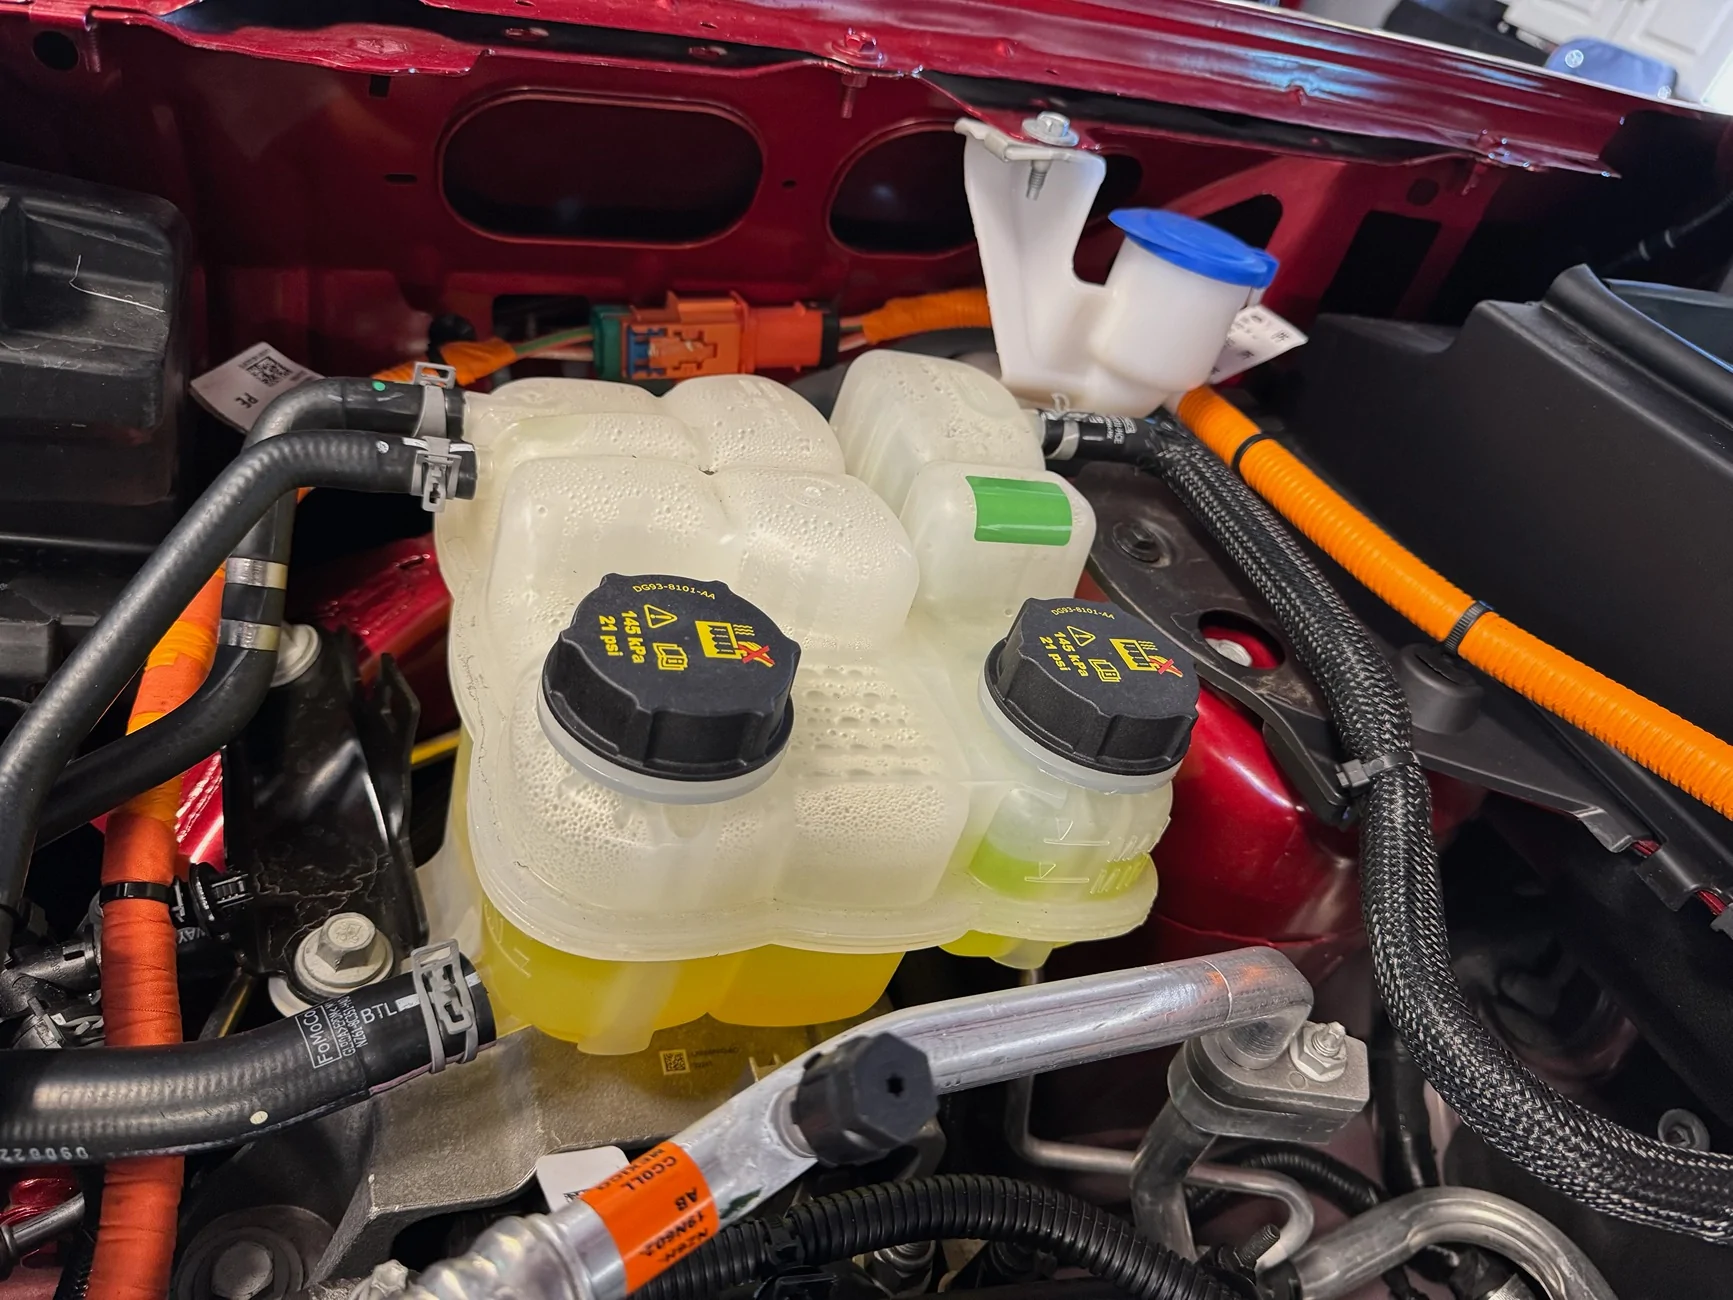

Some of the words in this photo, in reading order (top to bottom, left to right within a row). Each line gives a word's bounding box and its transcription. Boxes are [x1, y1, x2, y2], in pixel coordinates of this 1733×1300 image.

[632, 583, 717, 600] DG93-8101-AA
[599, 615, 617, 631] 21
[621, 610, 642, 636] 145
[1051, 606, 1115, 620] DG93-8101-AA
[599, 634, 623, 656] psi
[628, 637, 647, 664] kPa
[1039, 636, 1058, 650] 21
[1048, 653, 1072, 671] psi
[1053, 631, 1075, 652] 145
[1068, 654, 1089, 677] kPa
[360, 1003, 398, 1024] BTL
[675, 1188, 698, 1210] AB
